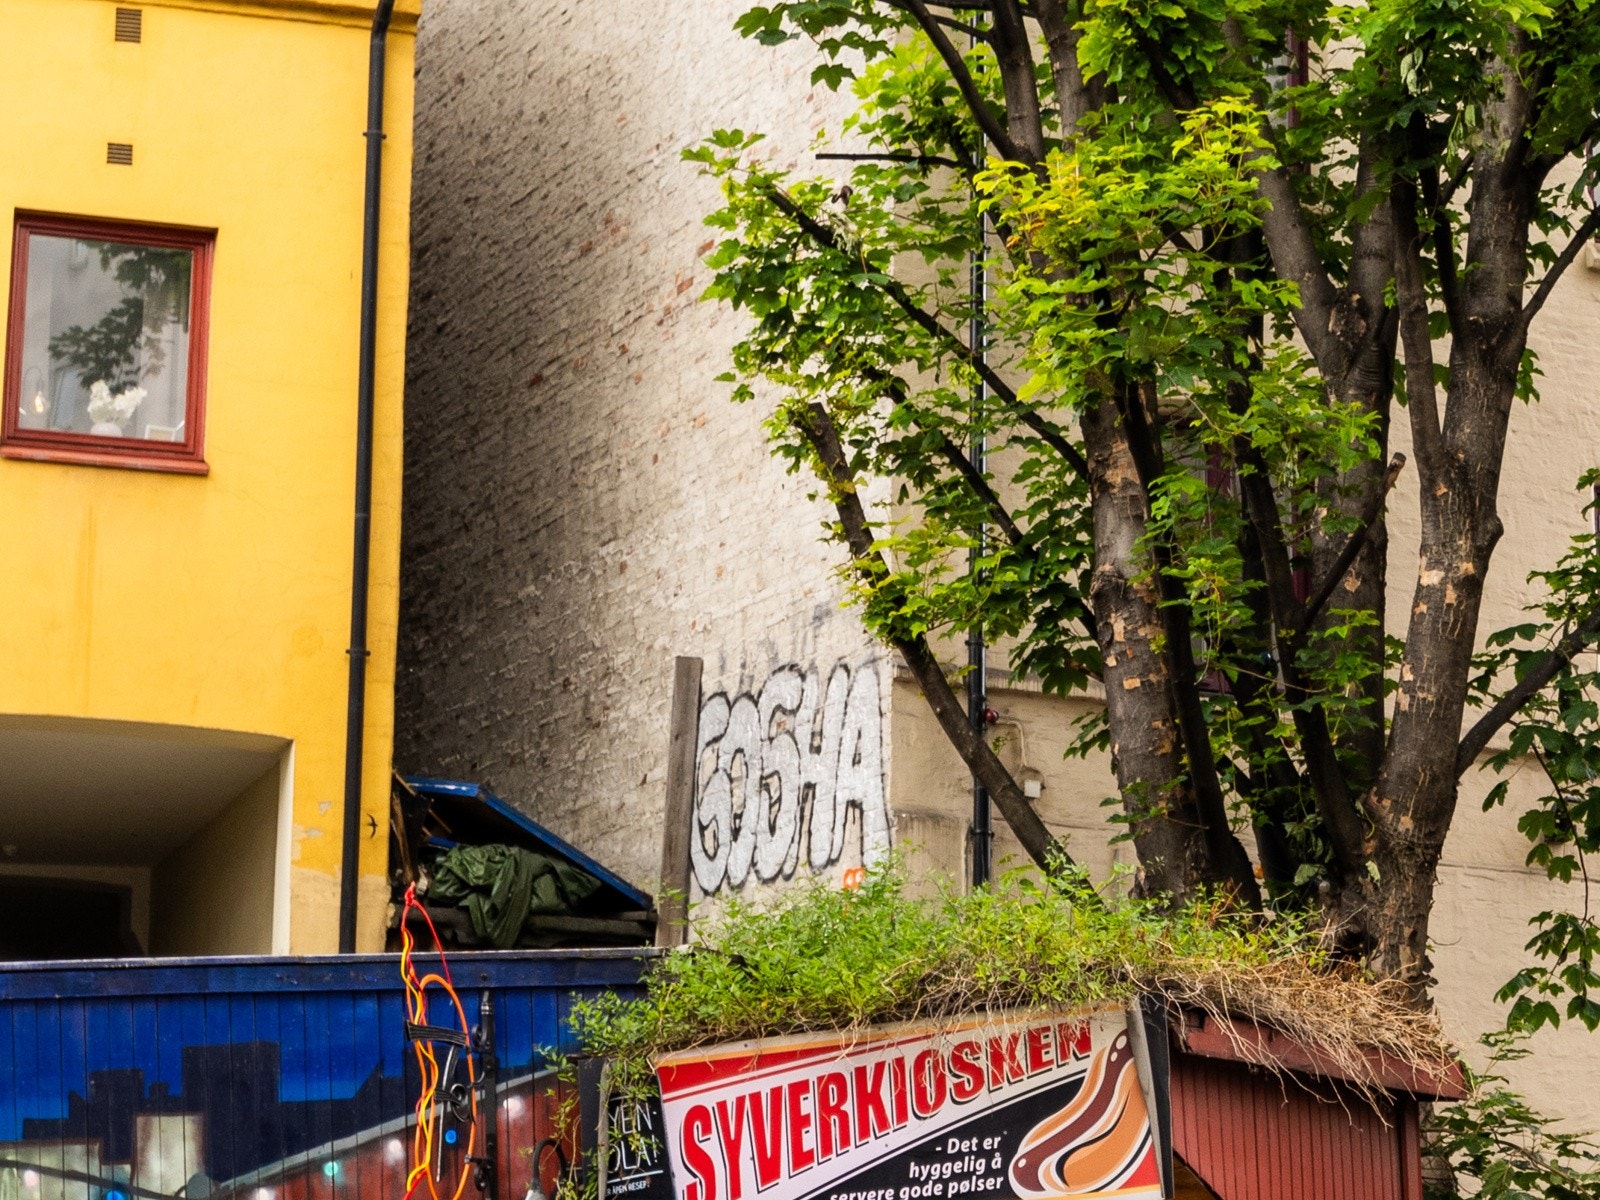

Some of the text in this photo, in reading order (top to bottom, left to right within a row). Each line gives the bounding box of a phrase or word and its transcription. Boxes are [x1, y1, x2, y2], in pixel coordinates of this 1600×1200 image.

[947, 1137, 978, 1154] Det
[983, 1136, 1001, 1150] er
[909, 1152, 1002, 1181] hyggelig å
[948, 1175, 1004, 1198] pølser
